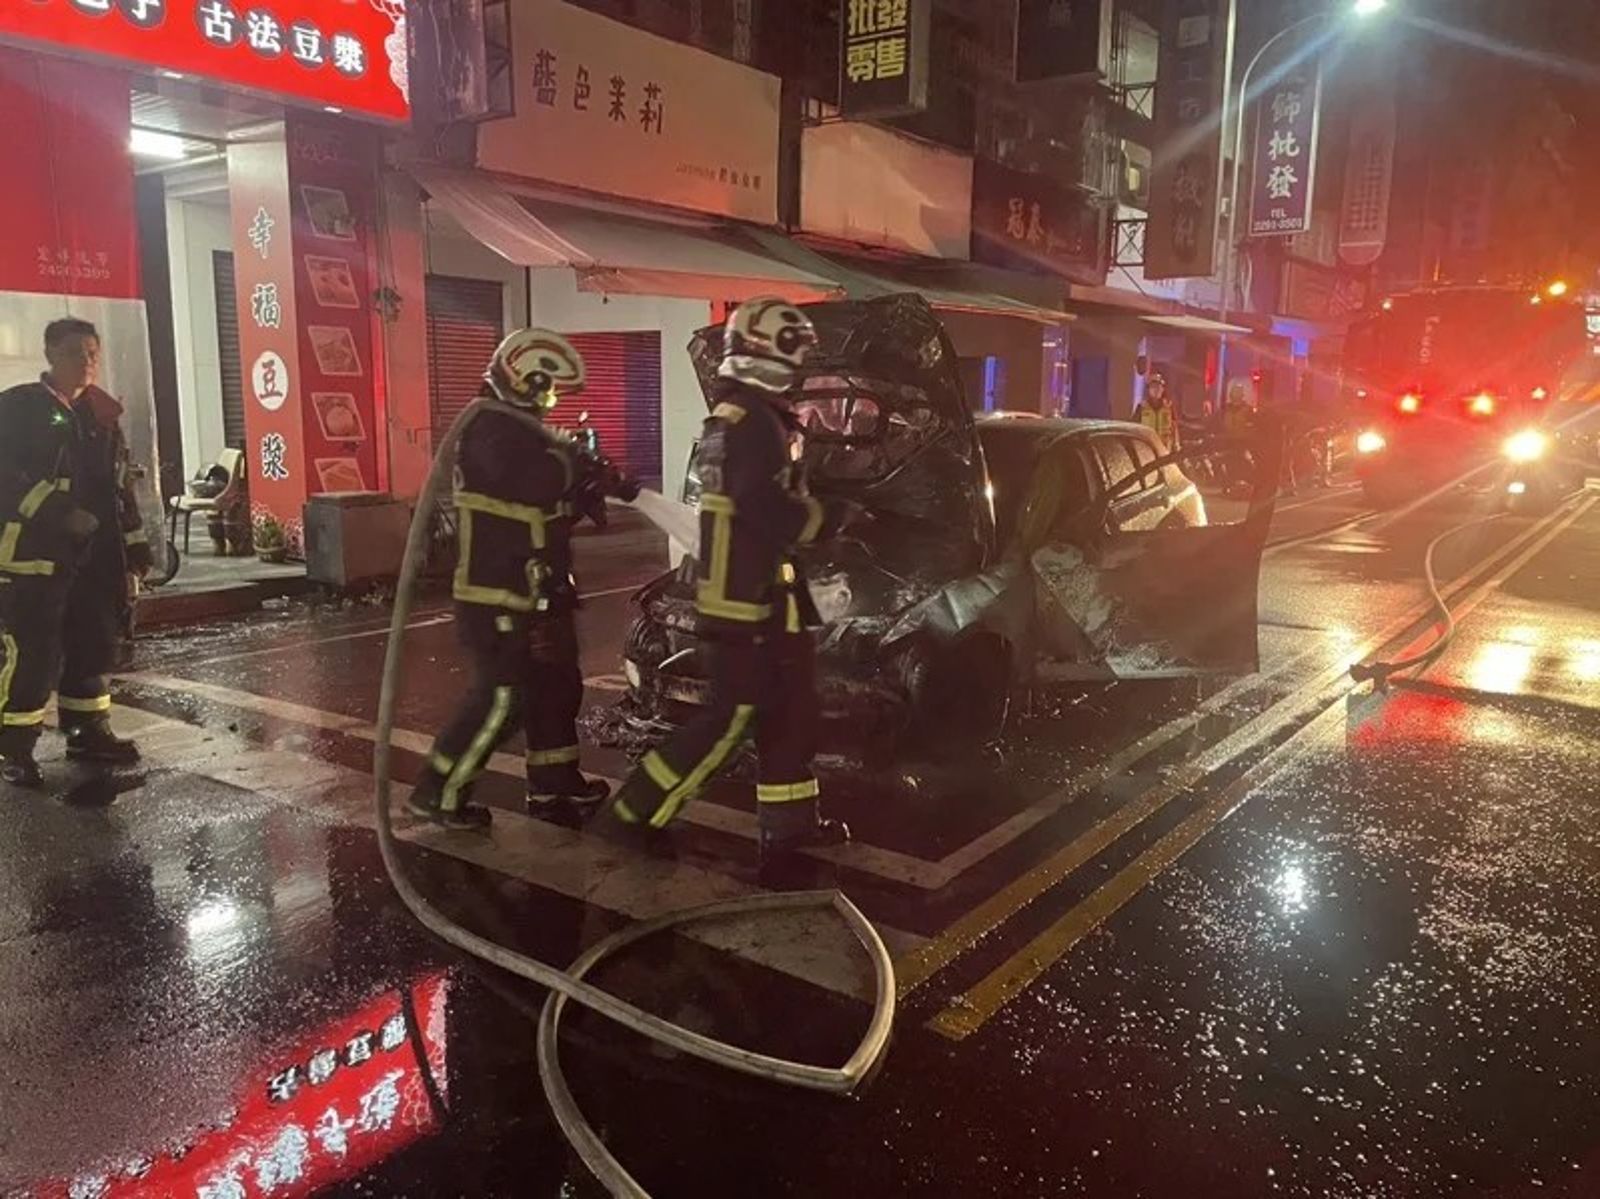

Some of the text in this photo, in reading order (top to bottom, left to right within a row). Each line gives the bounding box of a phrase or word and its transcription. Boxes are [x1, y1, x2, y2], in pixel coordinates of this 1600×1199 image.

[200, 3, 365, 72] 古法豆漿
[846, 38, 906, 83] 零售
[248, 207, 289, 480] 幸福豆漿
